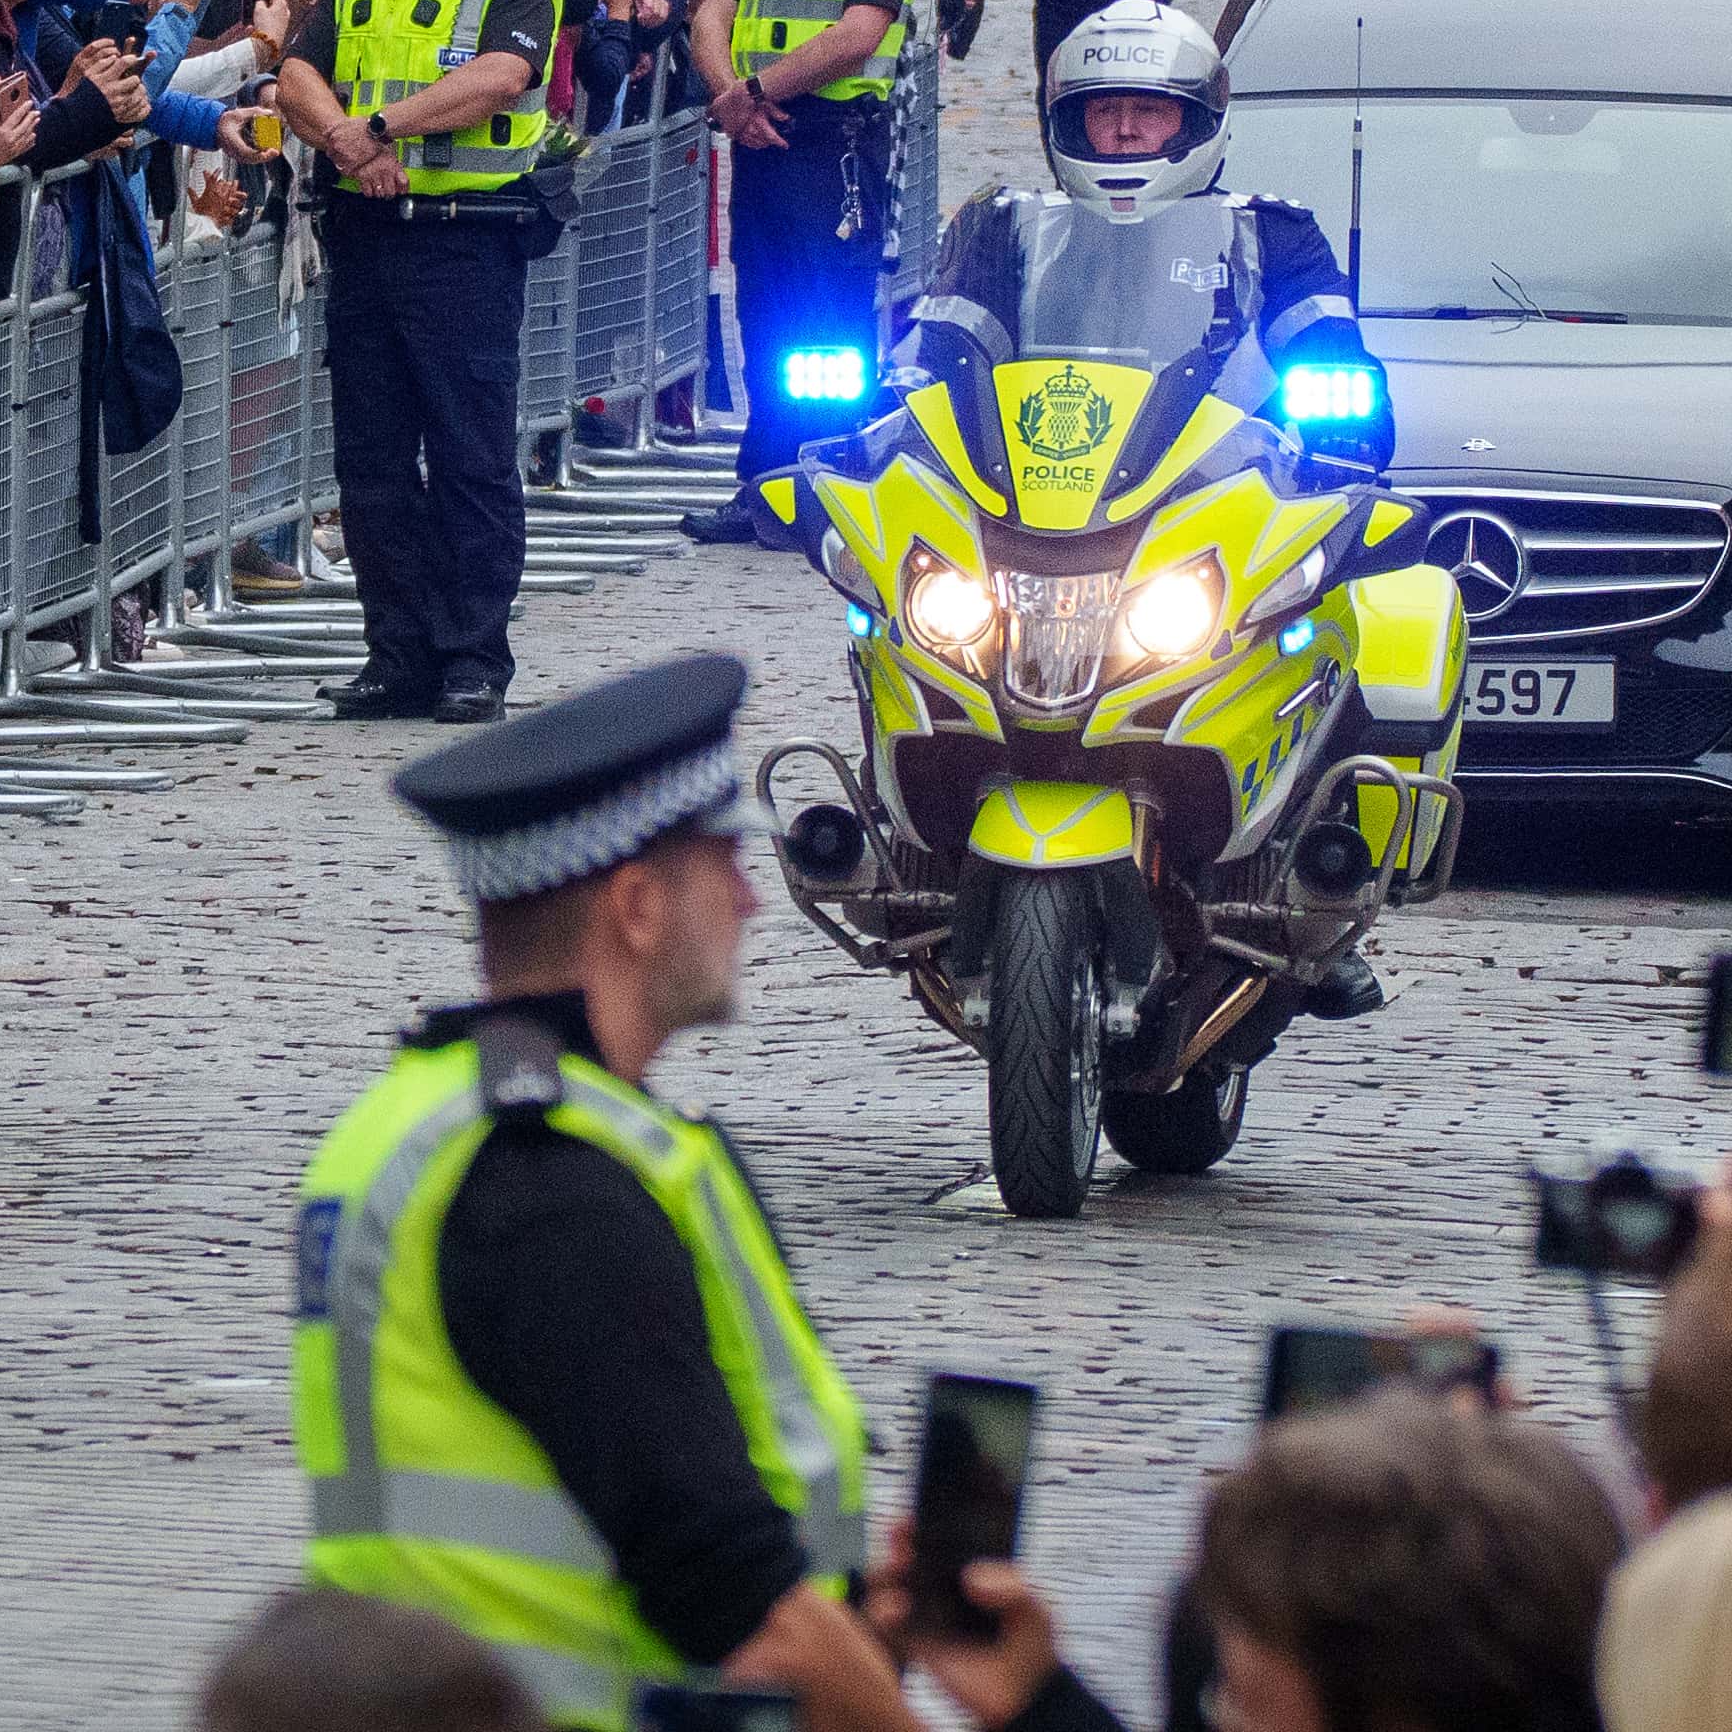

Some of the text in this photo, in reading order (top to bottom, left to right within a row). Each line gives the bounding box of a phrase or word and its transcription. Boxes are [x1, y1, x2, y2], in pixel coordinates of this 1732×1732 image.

[1083, 46, 1165, 67] POLICE
[1023, 465, 1096, 482] POLICE
[1021, 480, 1095, 493] SCOTLAND
